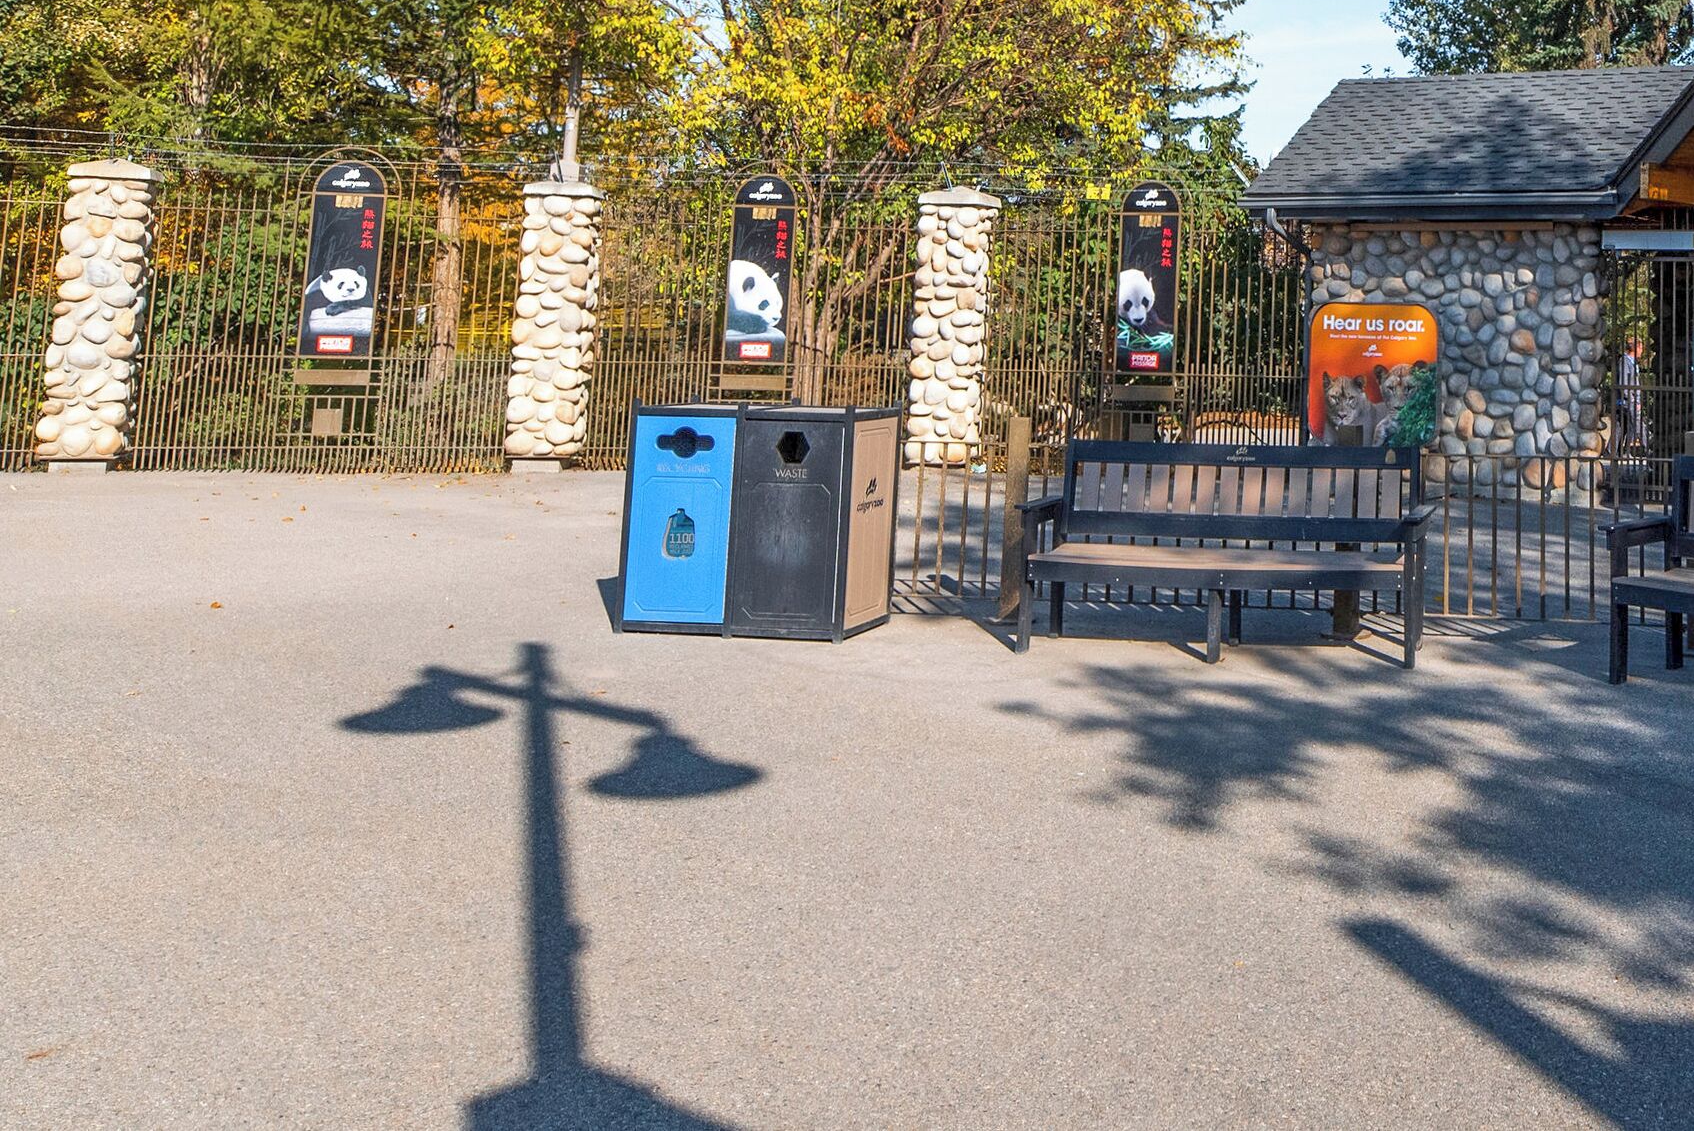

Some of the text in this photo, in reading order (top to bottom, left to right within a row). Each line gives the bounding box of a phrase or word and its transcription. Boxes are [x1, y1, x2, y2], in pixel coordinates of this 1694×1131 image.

[1323, 315, 1425, 332] Hear us roar.
[775, 468, 808, 479] WASTE
[857, 498, 884, 514] calgaryzoo
[669, 533, 694, 544] 1100
